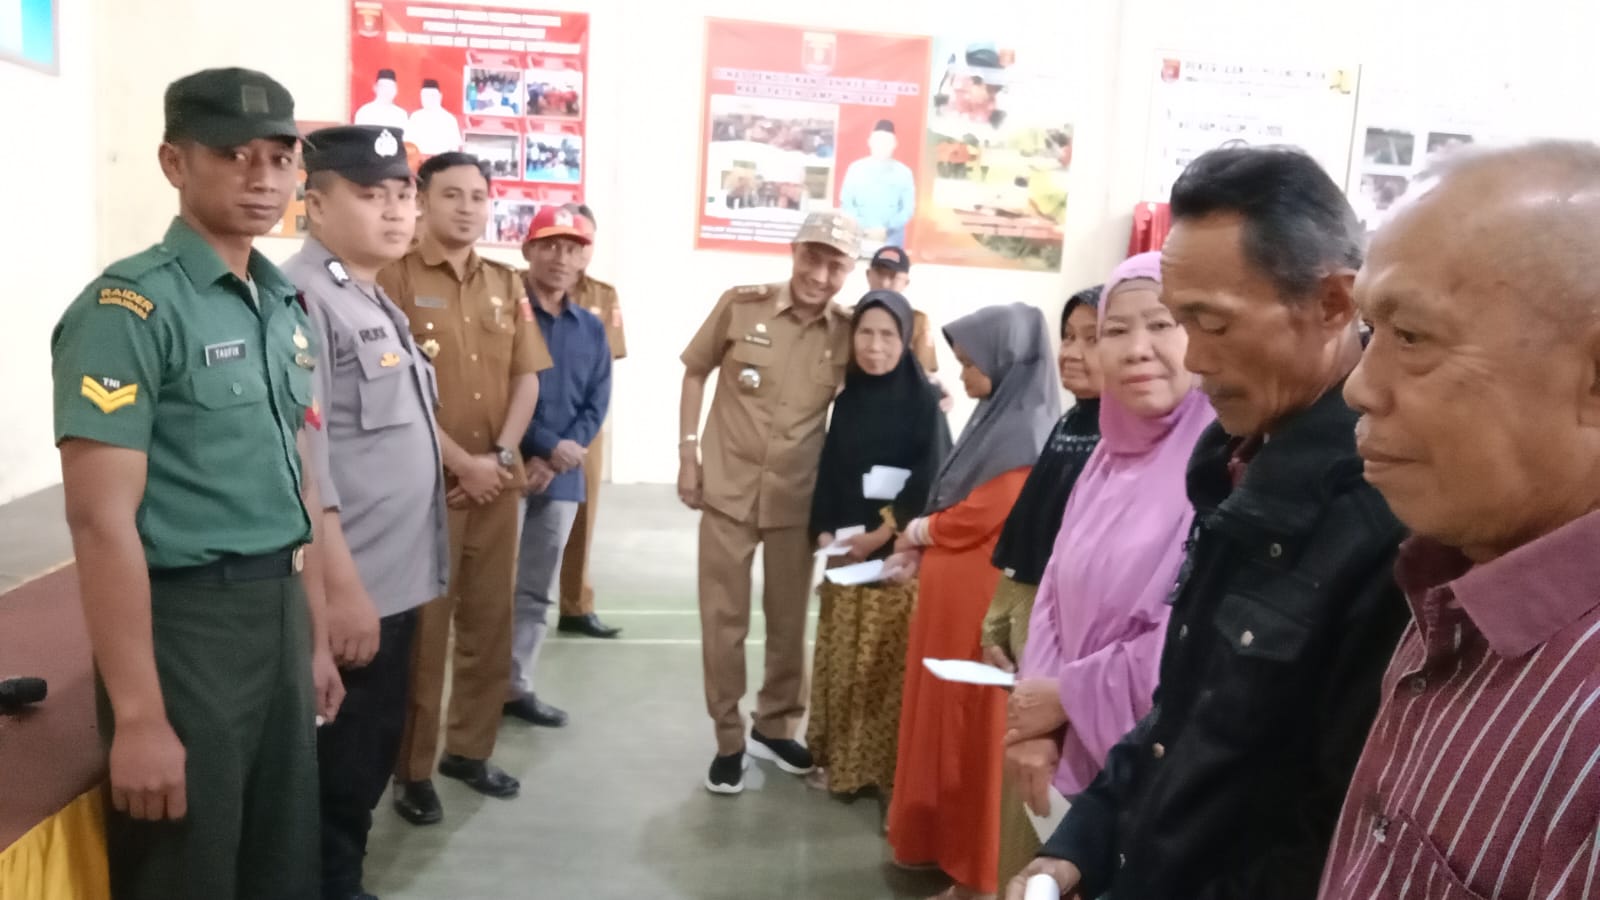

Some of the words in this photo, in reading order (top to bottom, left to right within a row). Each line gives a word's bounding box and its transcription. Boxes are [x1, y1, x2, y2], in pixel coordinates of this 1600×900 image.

[101, 288, 153, 312] RAIDER
[215, 346, 240, 360] TAUFIK
[103, 377, 120, 388] TNI
